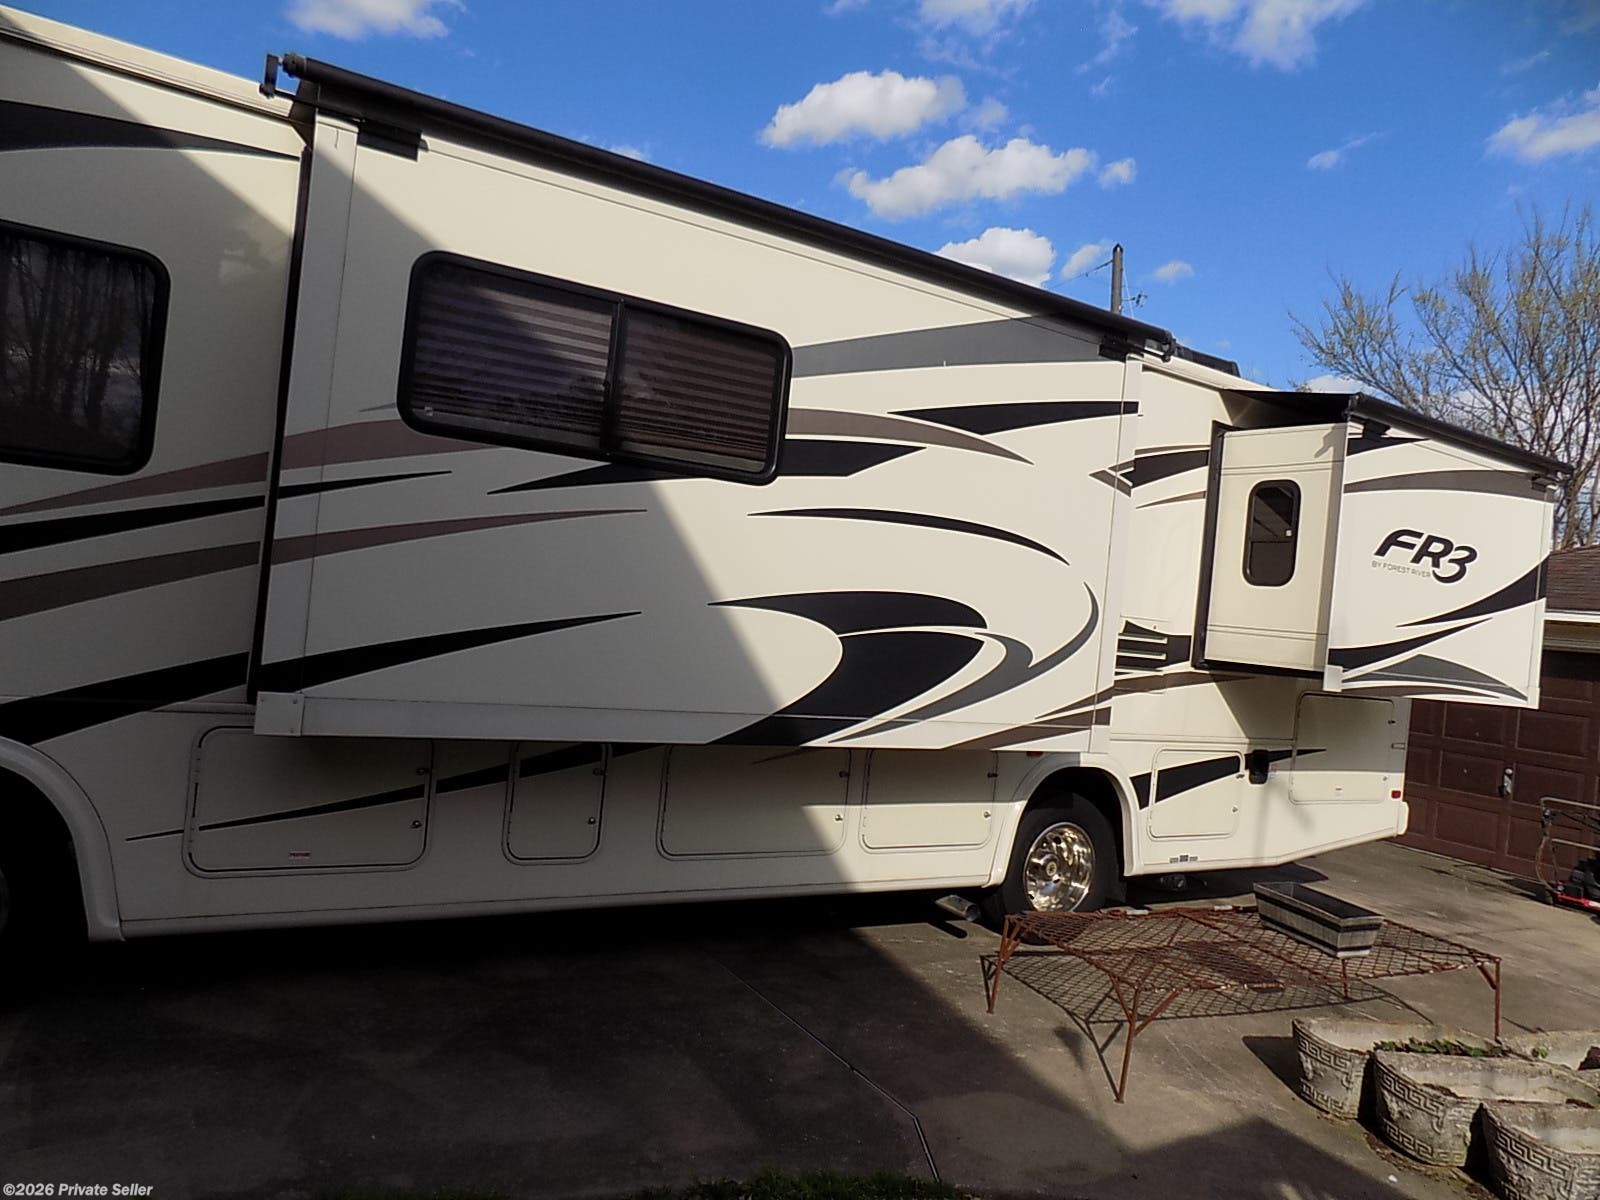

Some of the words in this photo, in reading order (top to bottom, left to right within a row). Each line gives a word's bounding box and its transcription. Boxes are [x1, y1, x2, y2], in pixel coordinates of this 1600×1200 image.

[1372, 560, 1382, 568] BY
[1383, 562, 1410, 574] FOREST
[1411, 568, 1431, 578] RIVER
[1373, 529, 1478, 583] FR3
